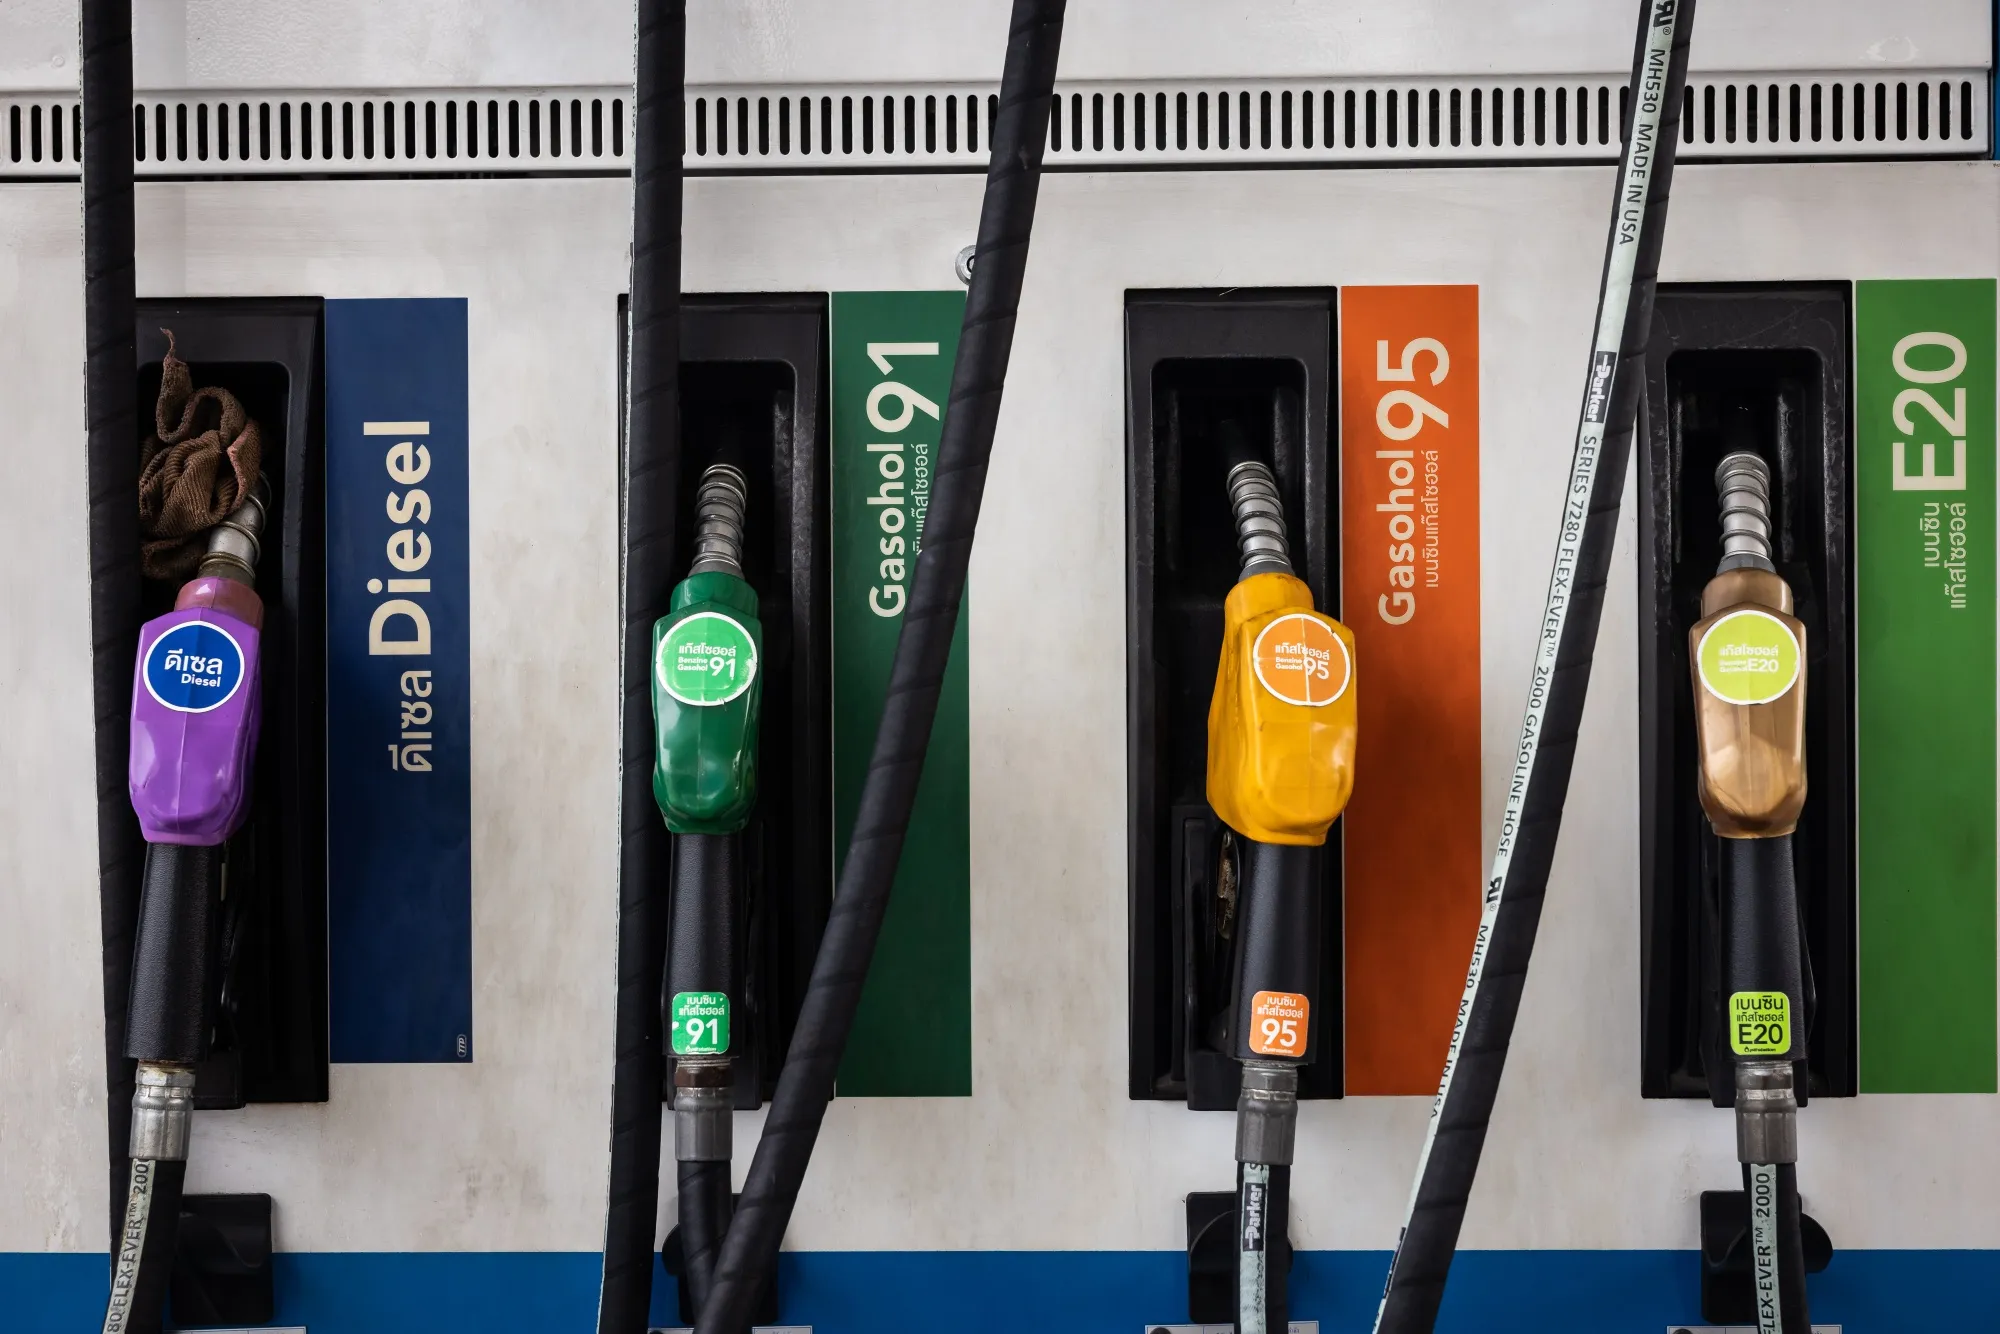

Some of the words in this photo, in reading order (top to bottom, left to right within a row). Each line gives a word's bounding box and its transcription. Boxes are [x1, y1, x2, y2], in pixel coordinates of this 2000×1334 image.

[1642, 49, 1665, 113] MH530
[1631, 123, 1653, 179] MADE
[1627, 184, 1643, 203] IN
[1619, 209, 1639, 245] USA
[866, 341, 940, 433] 91
[1376, 337, 1450, 441] 95
[1587, 356, 1611, 422] Parker
[1892, 331, 1967, 491] E20
[1574, 436, 1597, 493] SERIES
[363, 421, 432, 656] Diesel
[867, 443, 906, 618] Gasohol
[1376, 450, 1416, 625] Gasohol
[1564, 500, 1584, 542] 7280
[1919, 502, 1940, 568] เบนซิน
[1944, 502, 1967, 609] แก๊สโซฮอล์
[164, 648, 223, 675] ดีเซล
[181, 673, 221, 687] Diesel
[677, 664, 708, 672] Gasohol
[709, 656, 736, 680] 91
[1303, 657, 1329, 680] 95
[1747, 658, 1779, 673] E20
[1530, 666, 1549, 709] 2000
[388, 670, 432, 772] ดีเซล
[1509, 714, 1538, 804] GASOLINE
[1497, 809, 1517, 857] HOSE
[1466, 925, 1488, 989] MH530
[1736, 995, 1784, 1010] เบนซิน
[686, 1018, 718, 1045] 91
[1261, 1018, 1297, 1047] 95
[1738, 1023, 1783, 1044] E20
[133, 1158, 149, 1195] 200
[1755, 1173, 1771, 1218] 2000
[1245, 1184, 1262, 1249] Parker
